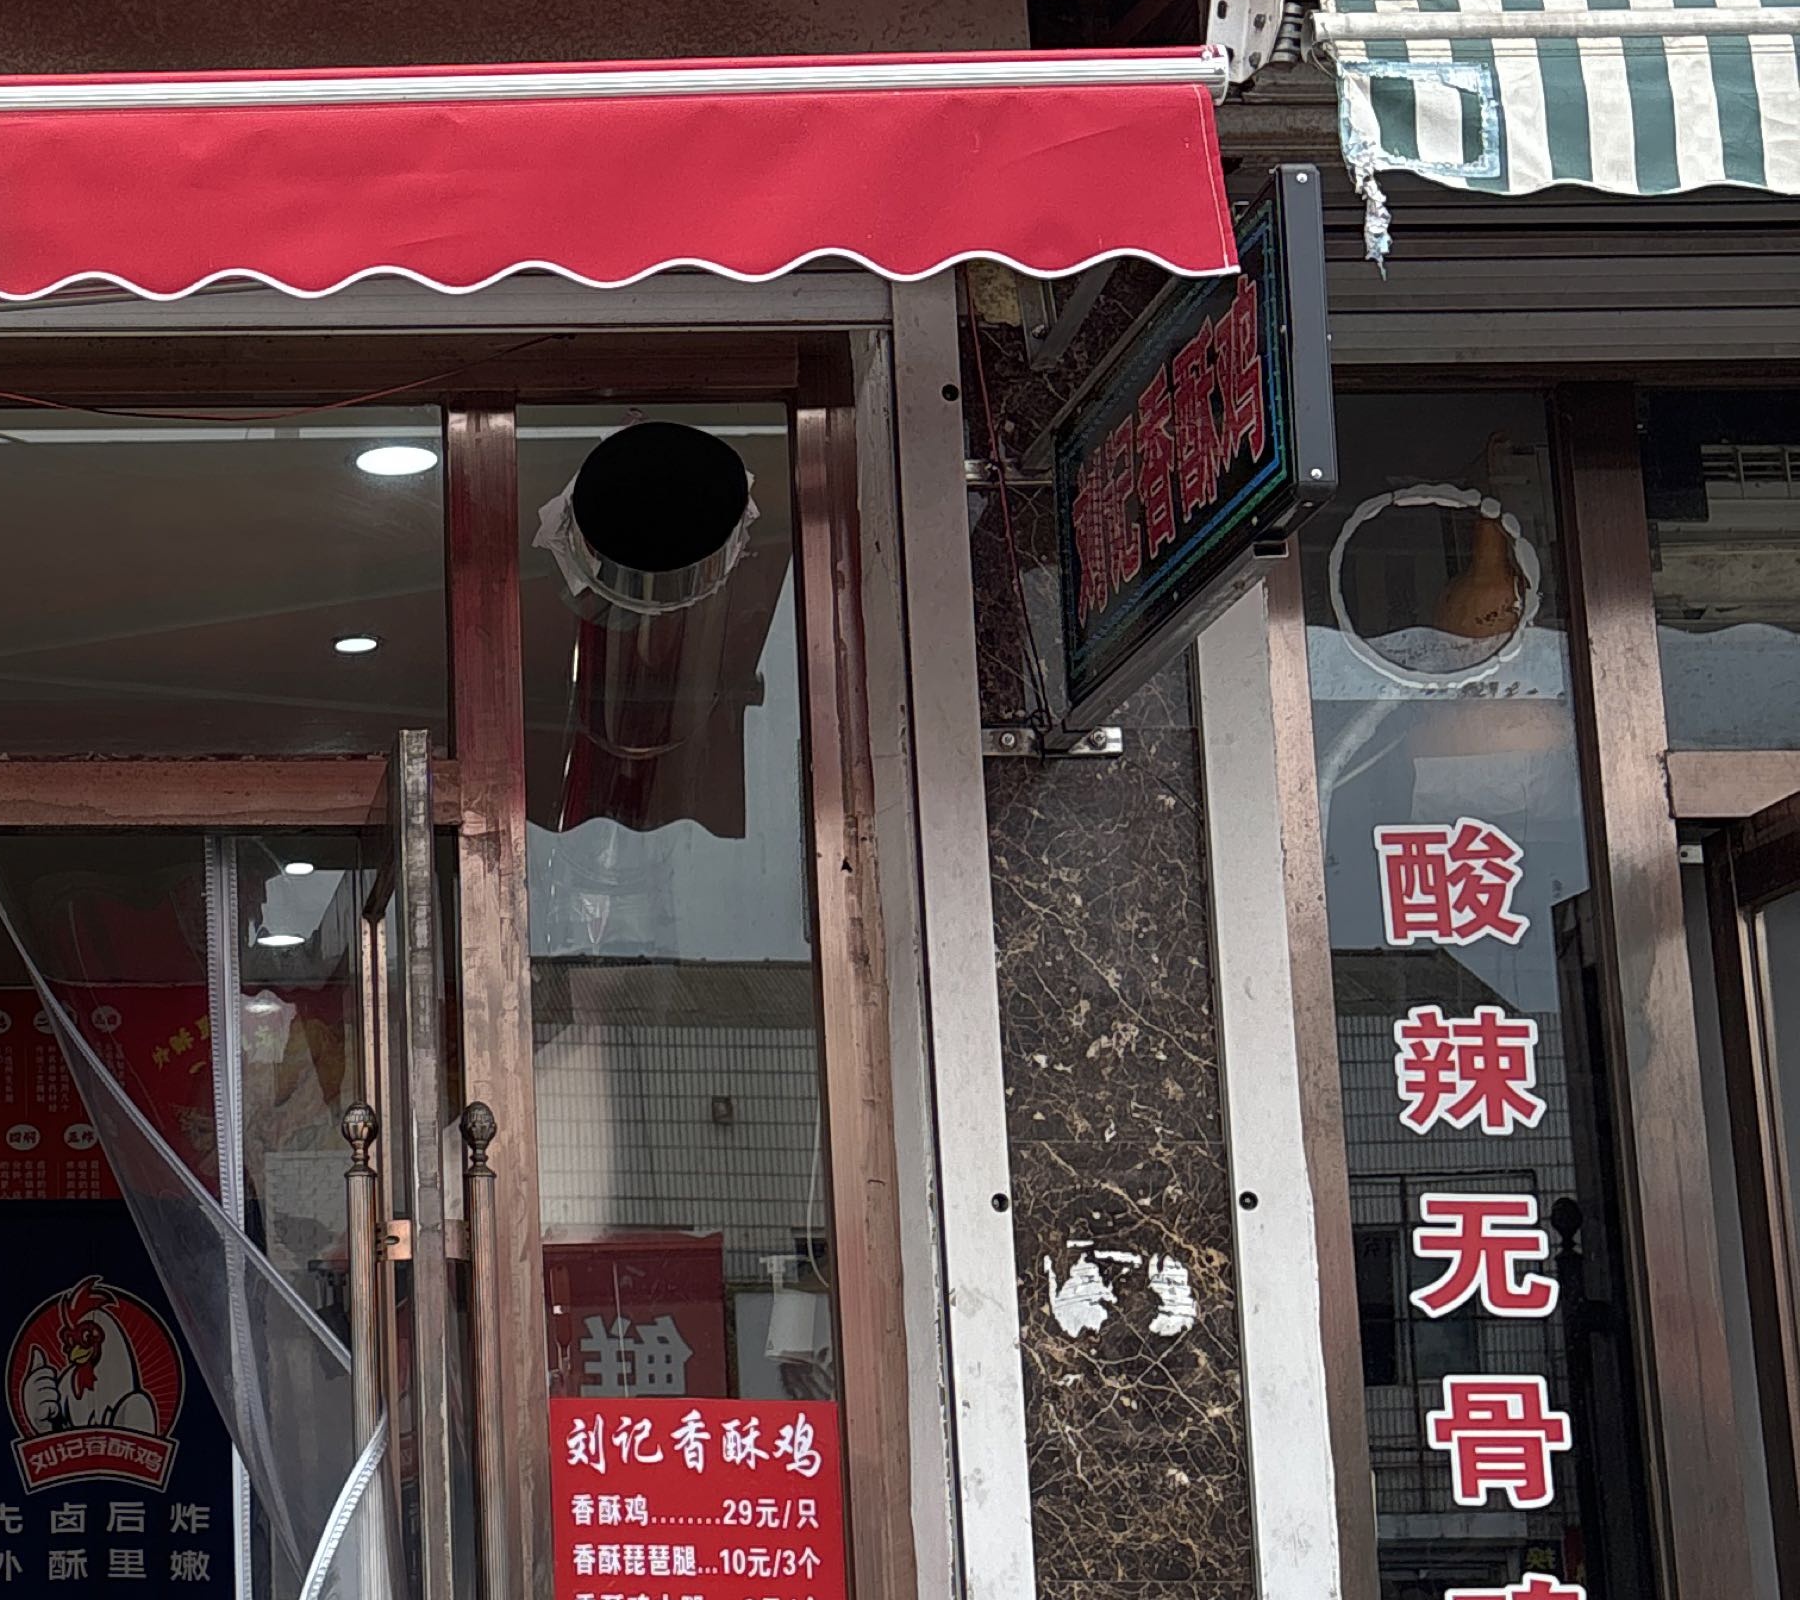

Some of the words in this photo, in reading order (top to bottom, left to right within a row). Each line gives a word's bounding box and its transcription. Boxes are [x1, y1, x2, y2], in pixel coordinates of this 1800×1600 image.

[1072, 276, 1270, 625] 刘记香酥鸡
[28, 1434, 165, 1475] 刘记香酥鸡
[566, 1409, 823, 1478] 刘记香酥鸡
